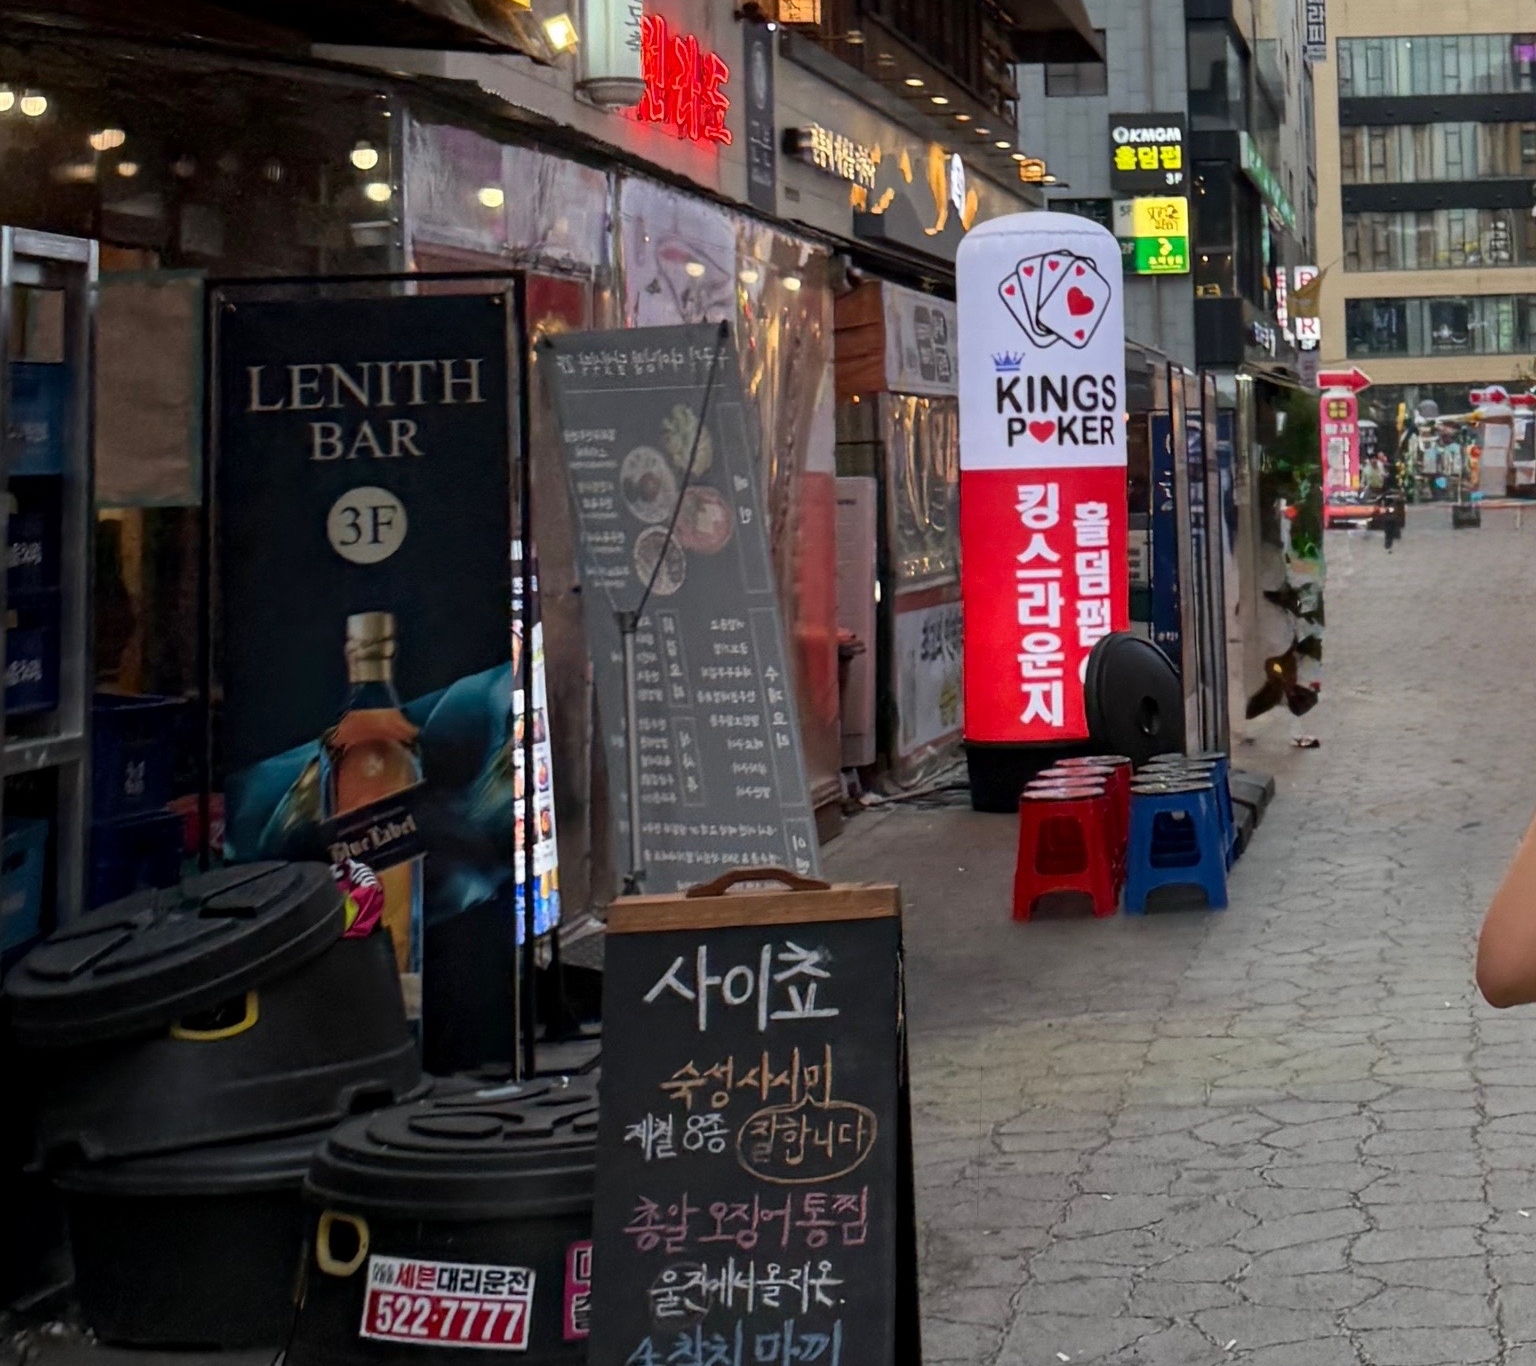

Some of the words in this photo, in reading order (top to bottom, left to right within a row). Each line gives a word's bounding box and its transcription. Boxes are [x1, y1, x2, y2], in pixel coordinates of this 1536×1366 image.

[1114, 145, 1182, 171] 홀덤펍
[246, 358, 487, 413] LENITH
[996, 374, 1118, 414] KINGS
[308, 419, 425, 461] BAR
[337, 505, 397, 546] 3F
[1015, 482, 1065, 728] 킹스라운지
[1072, 501, 1112, 683] 홀덤펍
[697, 1192, 792, 1249] 오징어
